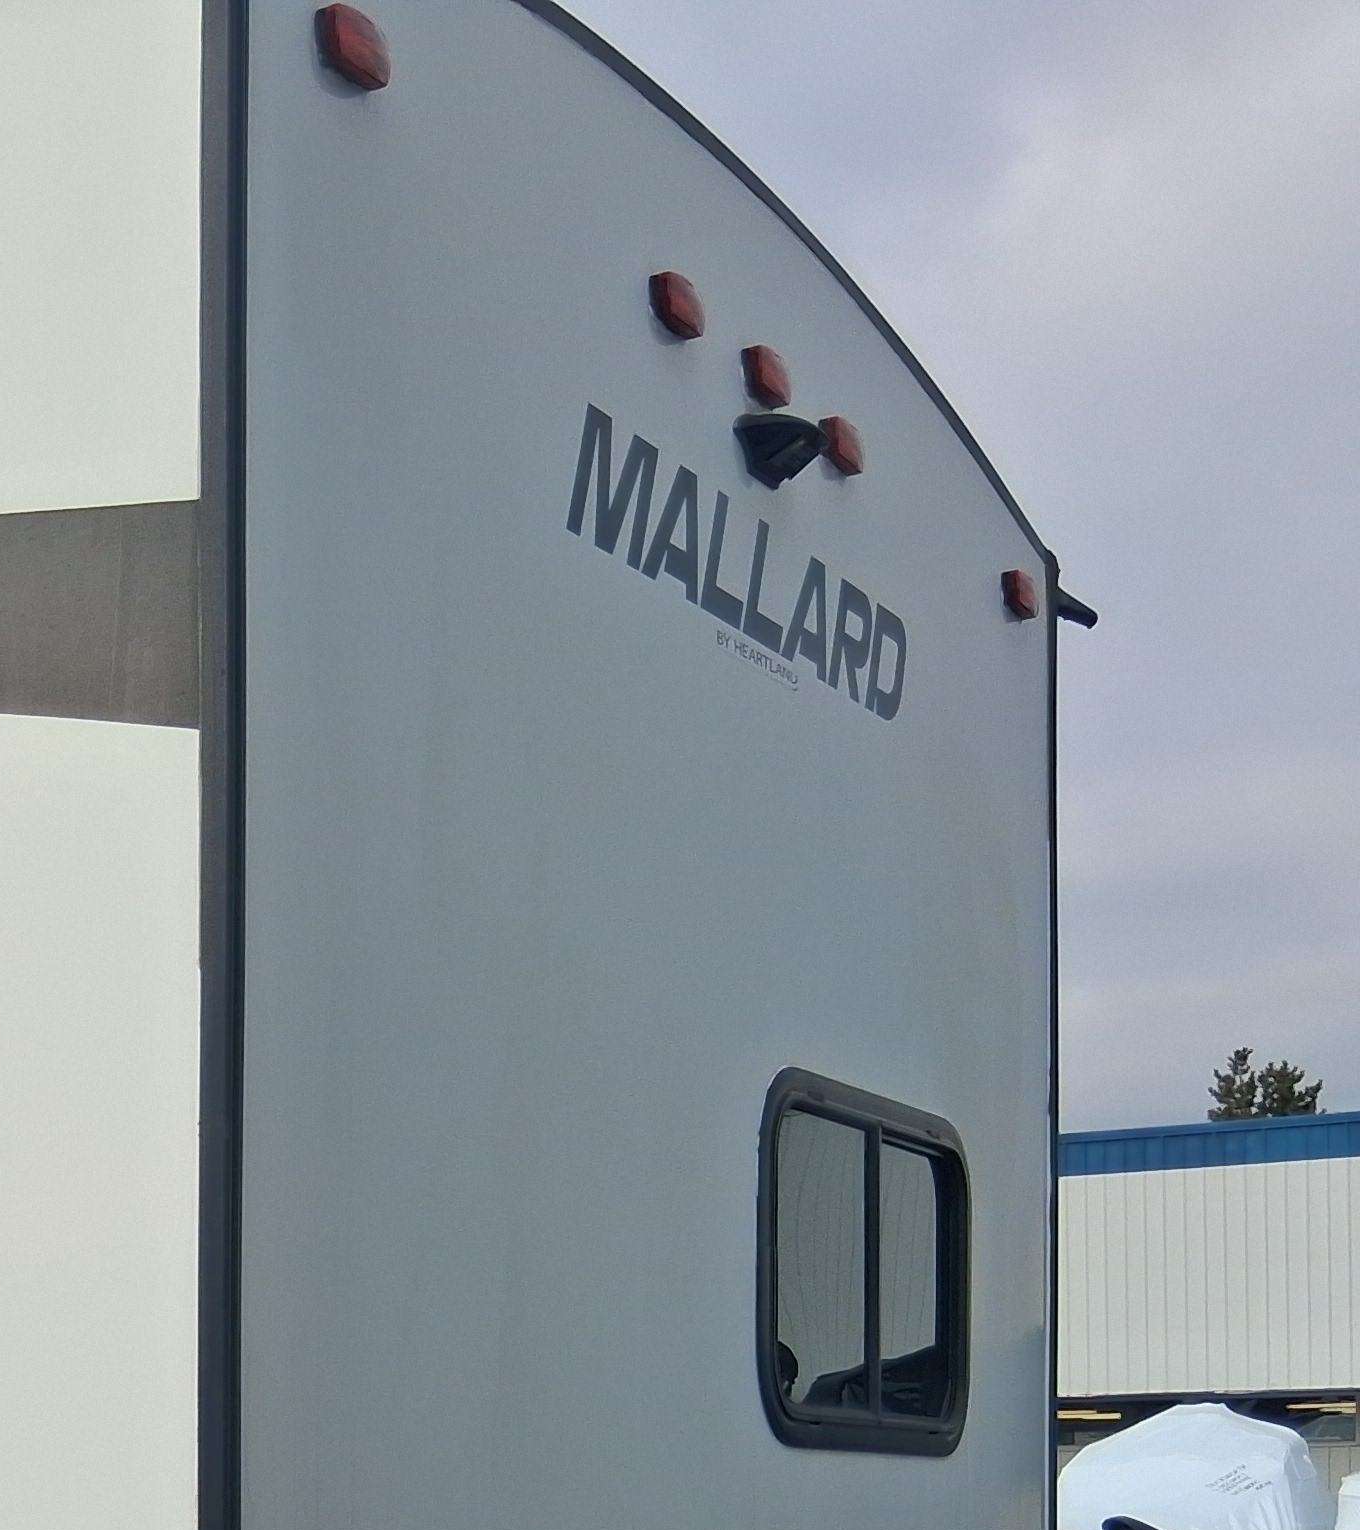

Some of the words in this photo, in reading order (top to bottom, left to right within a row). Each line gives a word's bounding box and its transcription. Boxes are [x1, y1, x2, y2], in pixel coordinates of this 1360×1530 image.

[566, 402, 907, 721] MALLARD
[716, 630, 730, 648] BY
[733, 640, 799, 685] HEARTLAND
